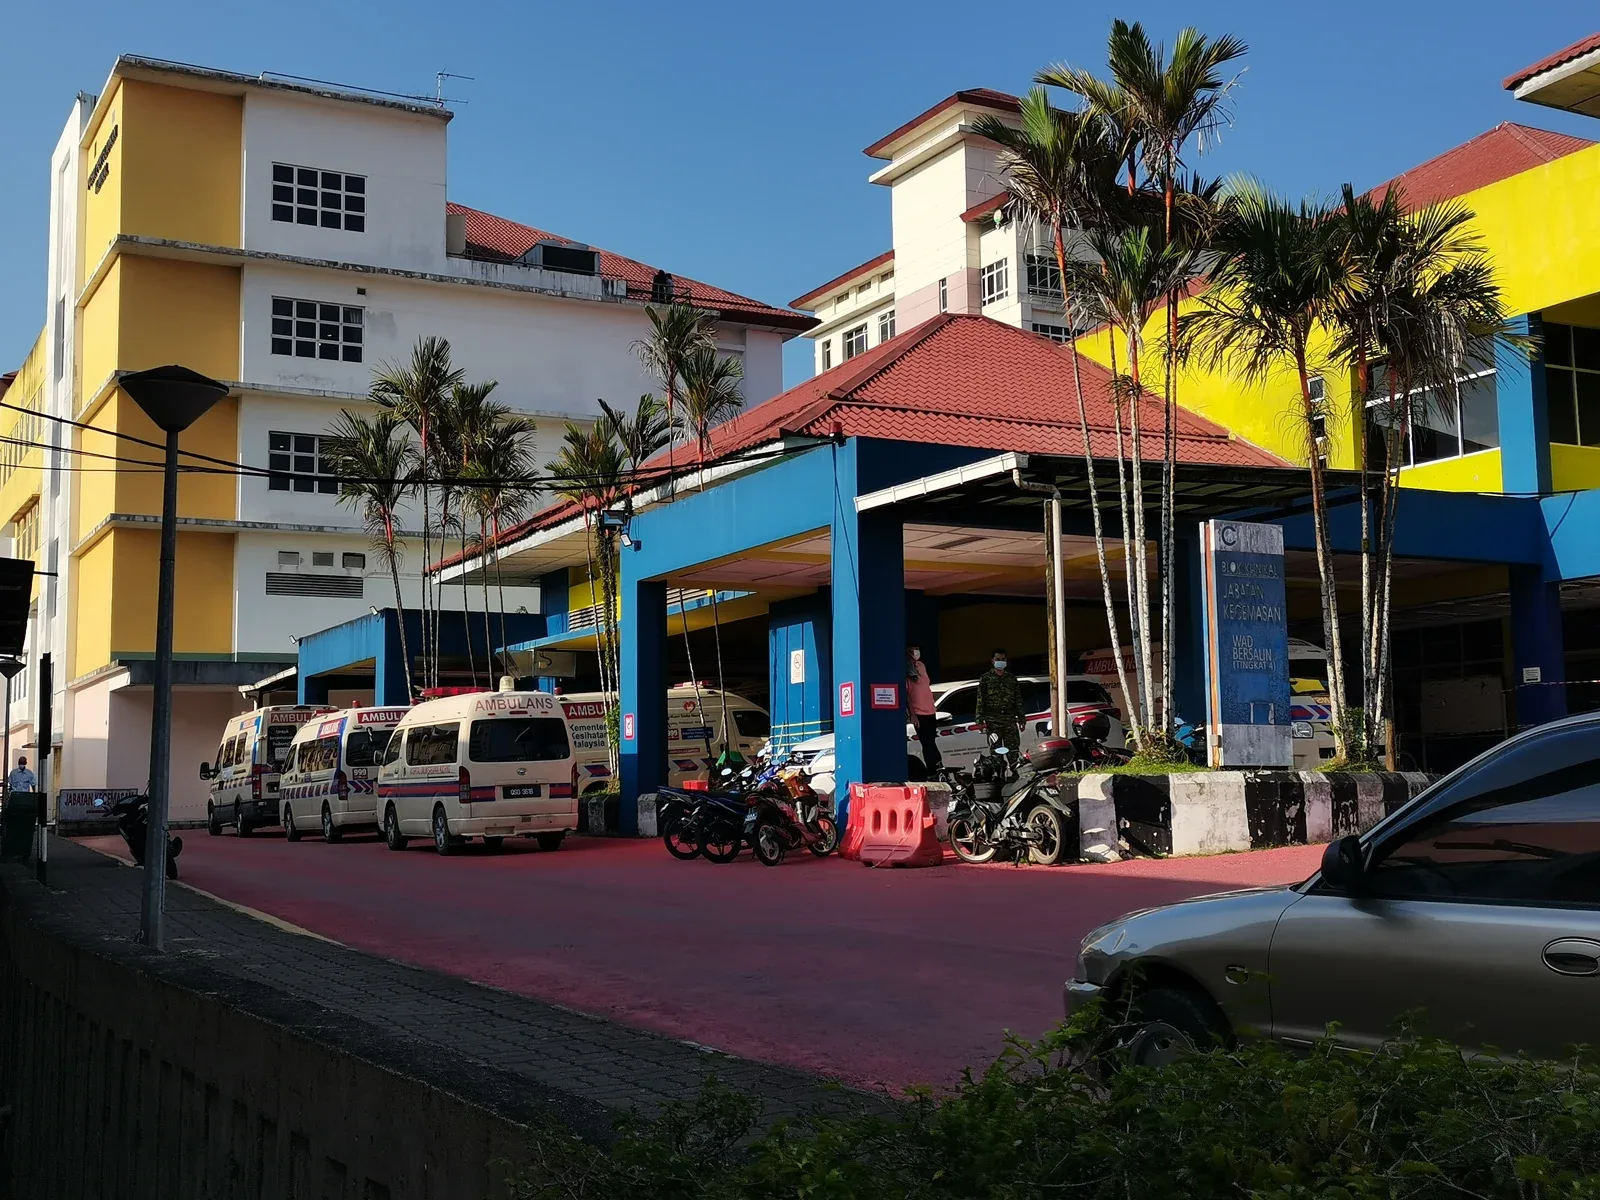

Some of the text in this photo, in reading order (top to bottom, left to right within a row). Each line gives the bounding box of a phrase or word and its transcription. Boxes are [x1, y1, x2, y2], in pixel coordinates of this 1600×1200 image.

[1222, 526, 1236, 546] C
[1232, 634, 1253, 648] WAD
[1232, 648, 1272, 661] BERSALIN
[475, 698, 554, 712] AMBULANS
